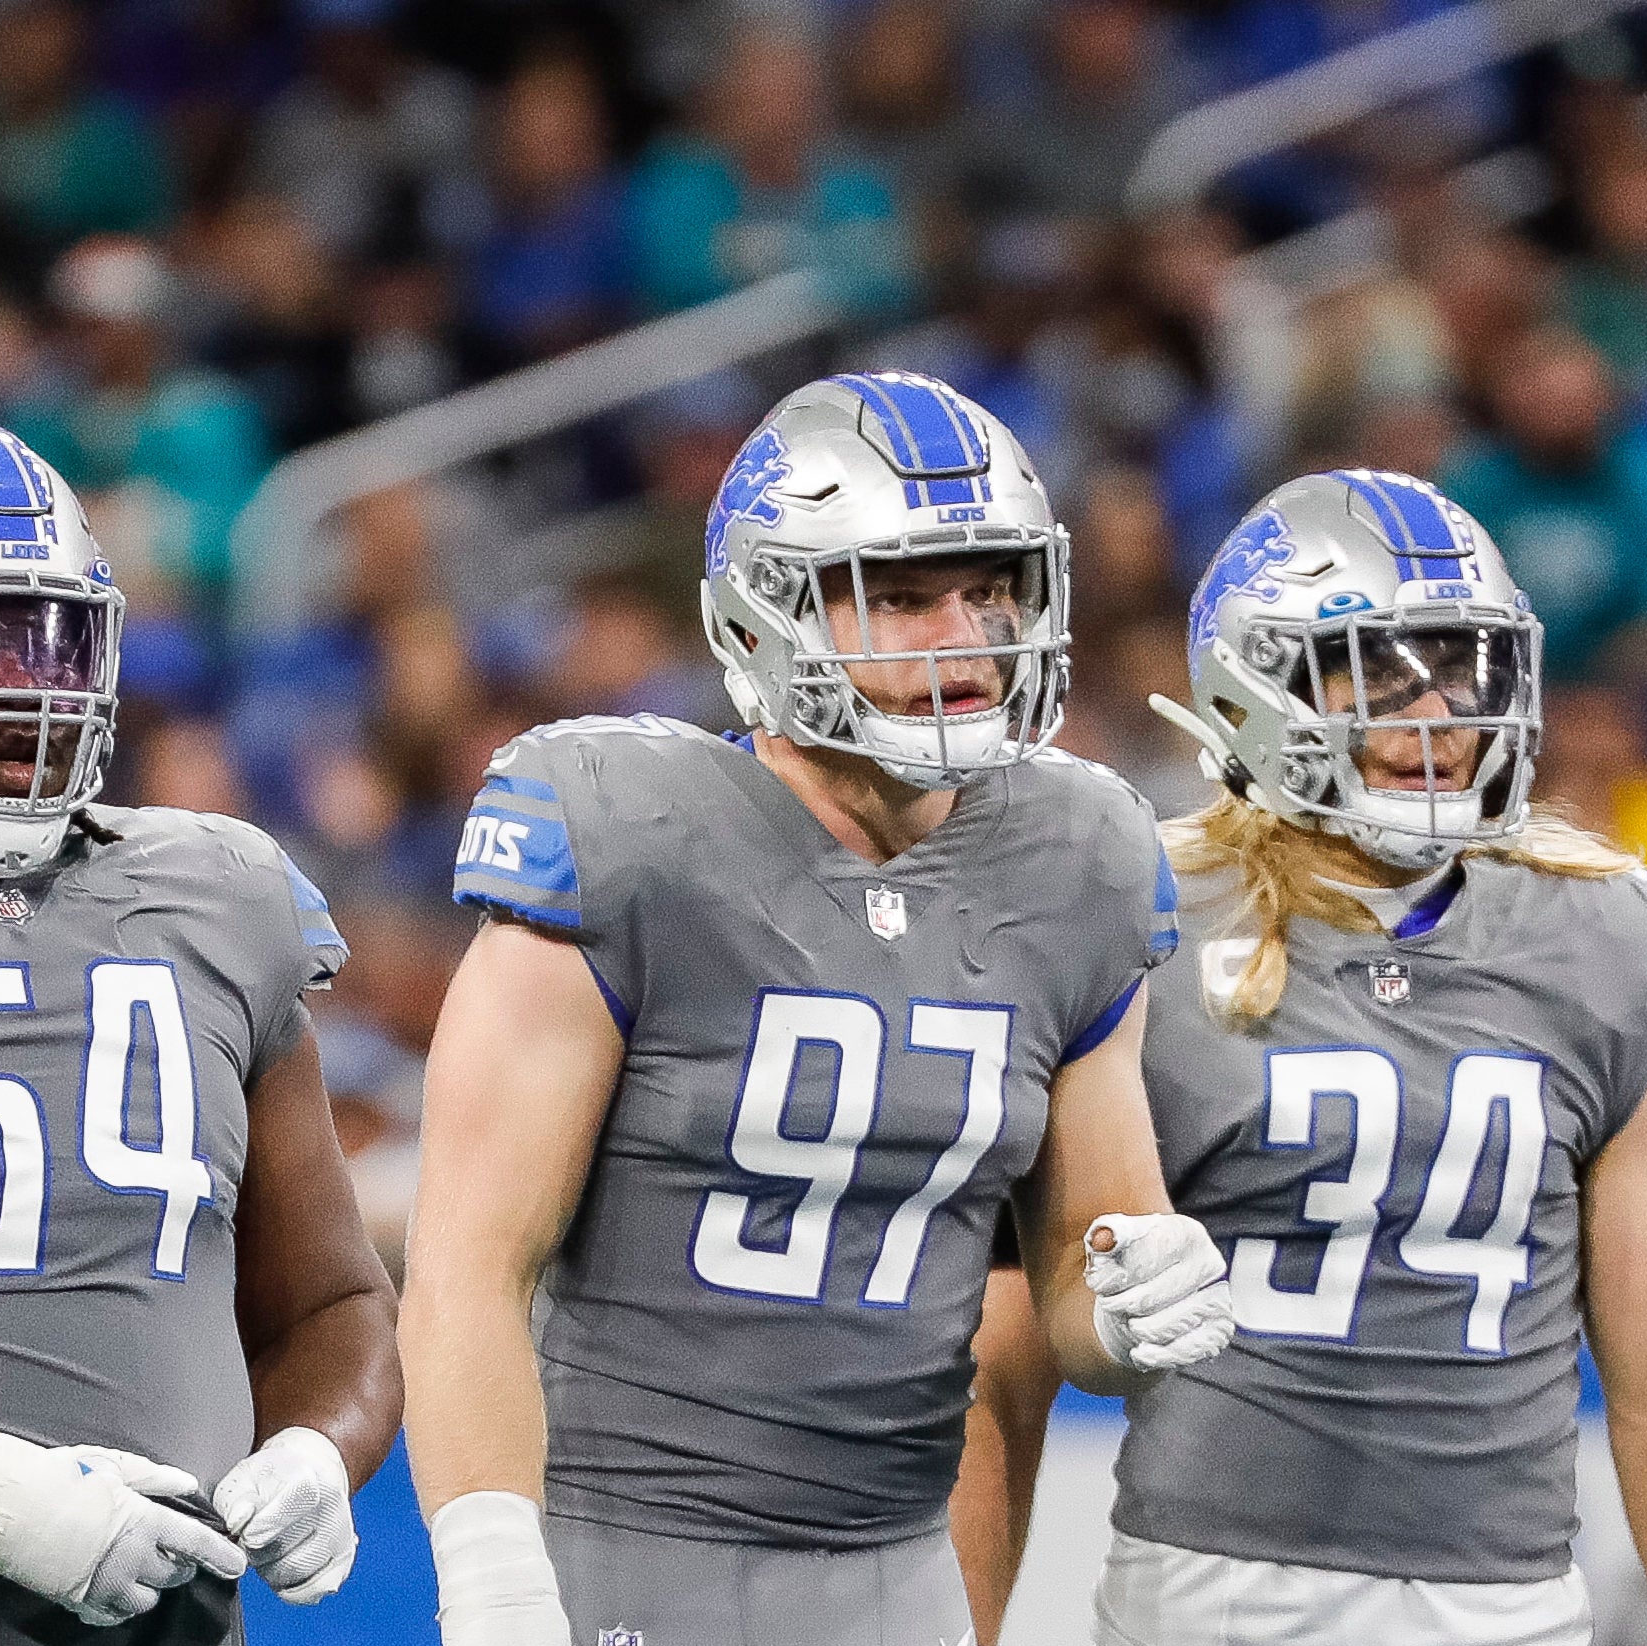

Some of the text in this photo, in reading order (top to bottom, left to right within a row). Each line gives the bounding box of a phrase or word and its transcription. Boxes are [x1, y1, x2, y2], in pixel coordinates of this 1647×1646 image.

[455, 815, 530, 872] ONS
[686, 986, 1014, 1308] 97
[1230, 1046, 1550, 1355] 34
